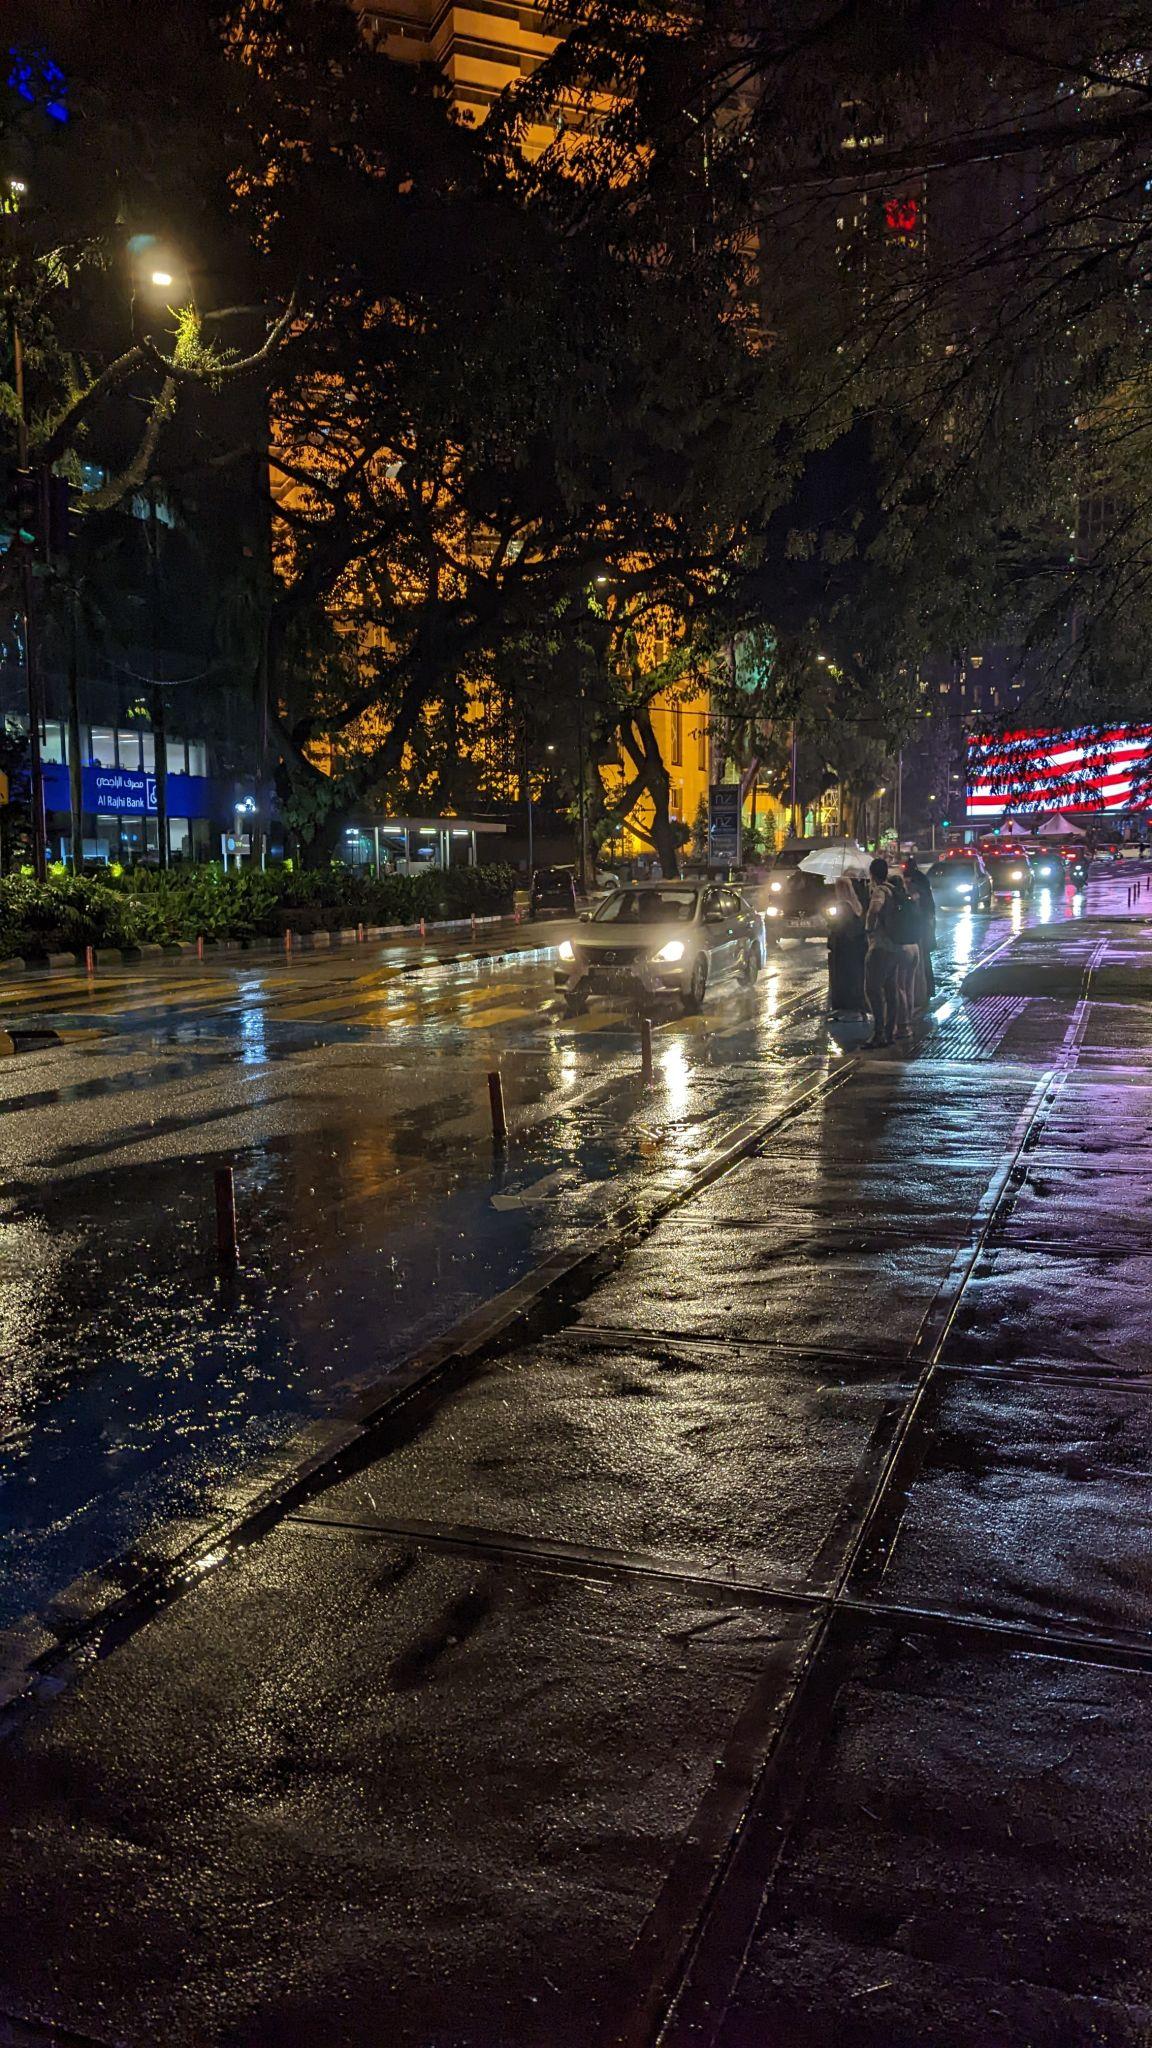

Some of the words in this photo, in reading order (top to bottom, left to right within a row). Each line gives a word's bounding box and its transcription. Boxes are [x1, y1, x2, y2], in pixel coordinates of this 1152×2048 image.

[96, 775, 123, 789] الراجحي
[123, 777, 144, 790] مصرف
[97, 795, 106, 806] Al
[107, 796, 126, 809] Rajhi
[126, 797, 145, 808] Bank
